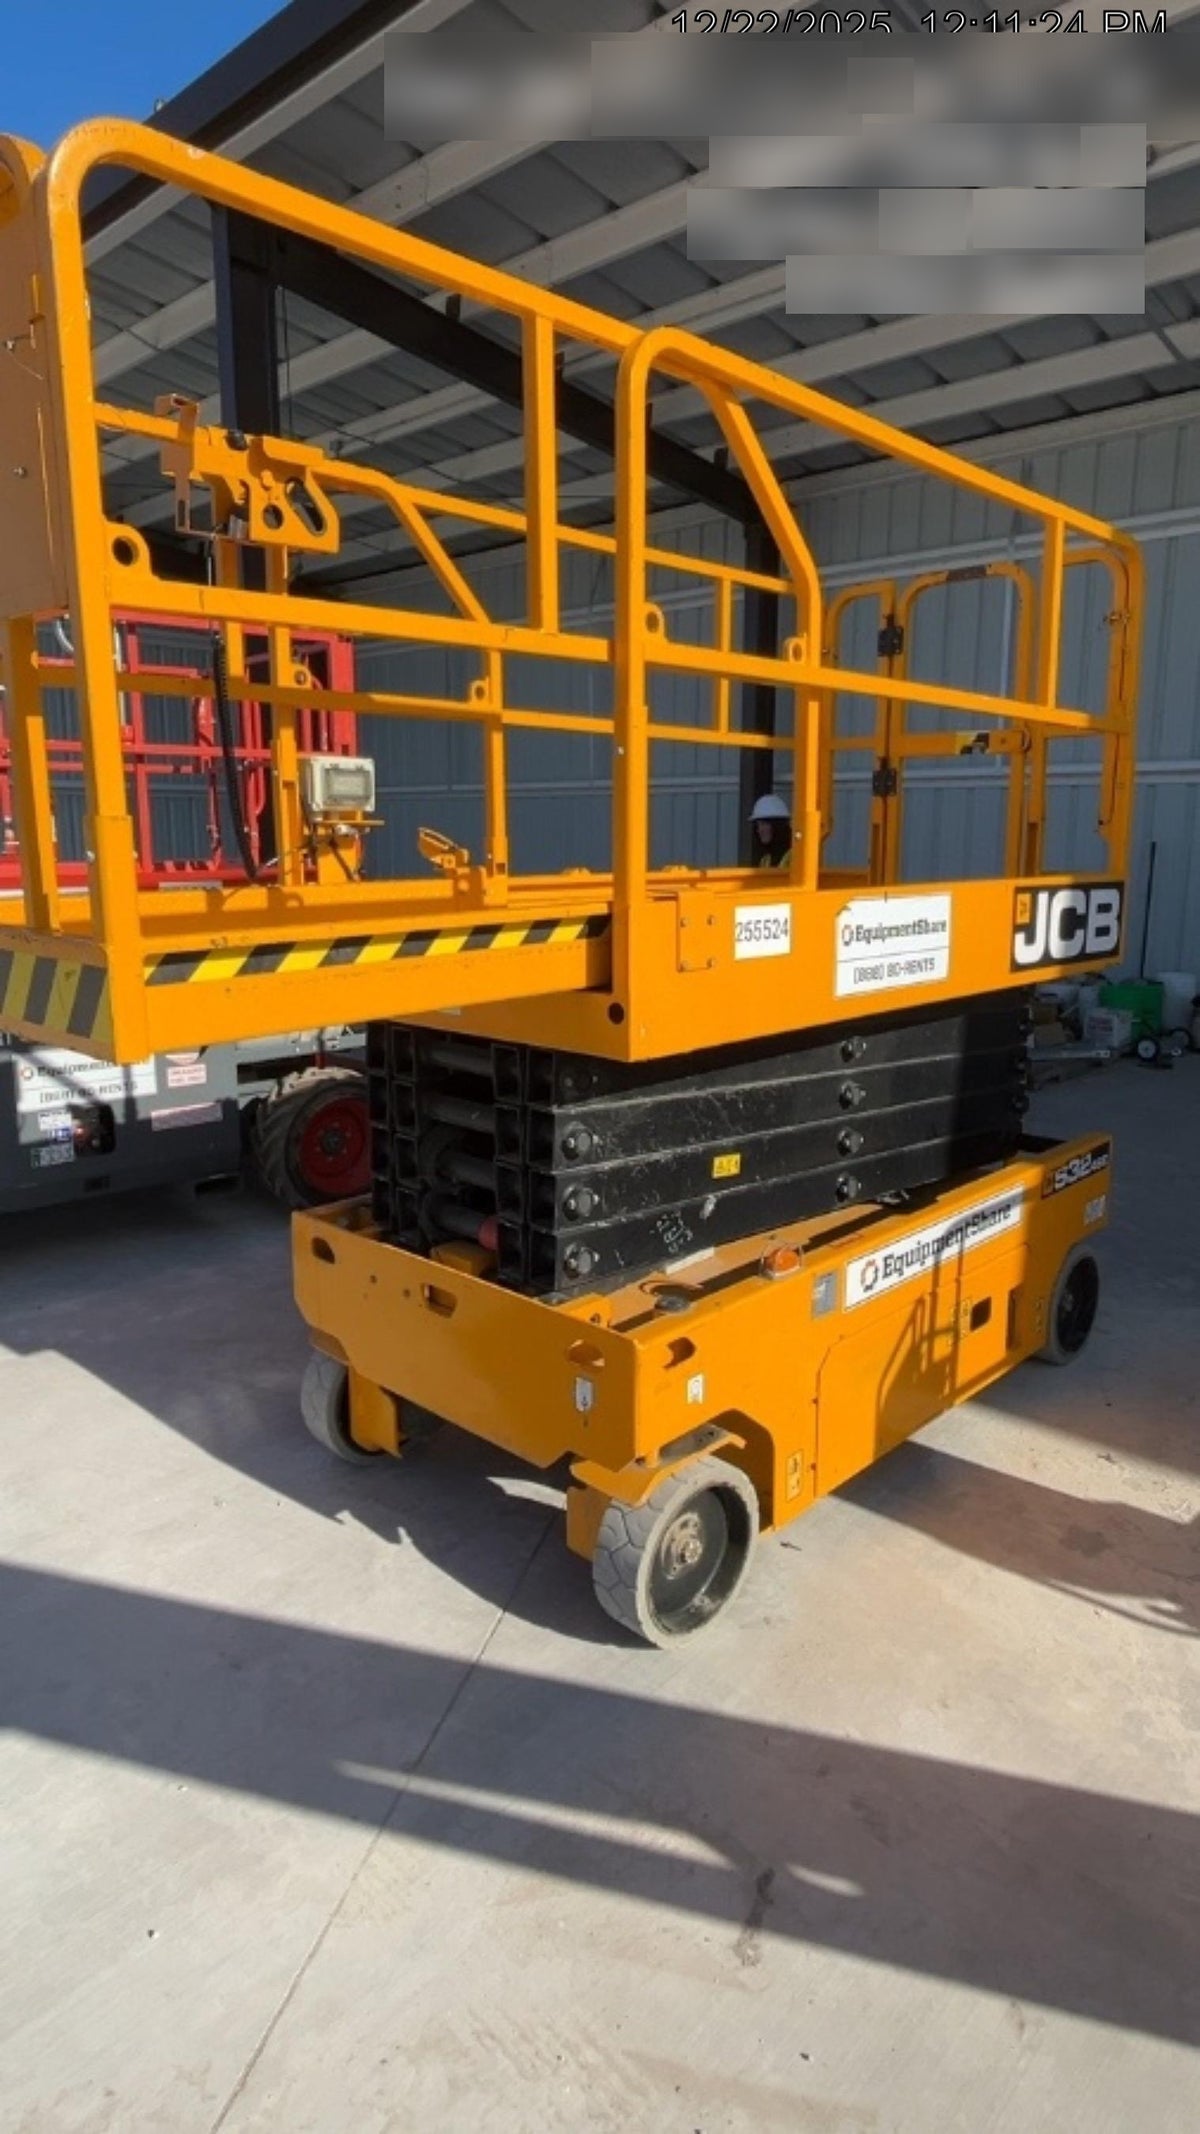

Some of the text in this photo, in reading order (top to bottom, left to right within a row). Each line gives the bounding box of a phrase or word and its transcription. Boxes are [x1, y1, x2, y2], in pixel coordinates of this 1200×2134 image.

[735, 917, 788, 942] 255524
[855, 917, 947, 945] EquipmentShare
[1014, 887, 1121, 965] JCB
[881, 1203, 1013, 1281] EquipmentShare
